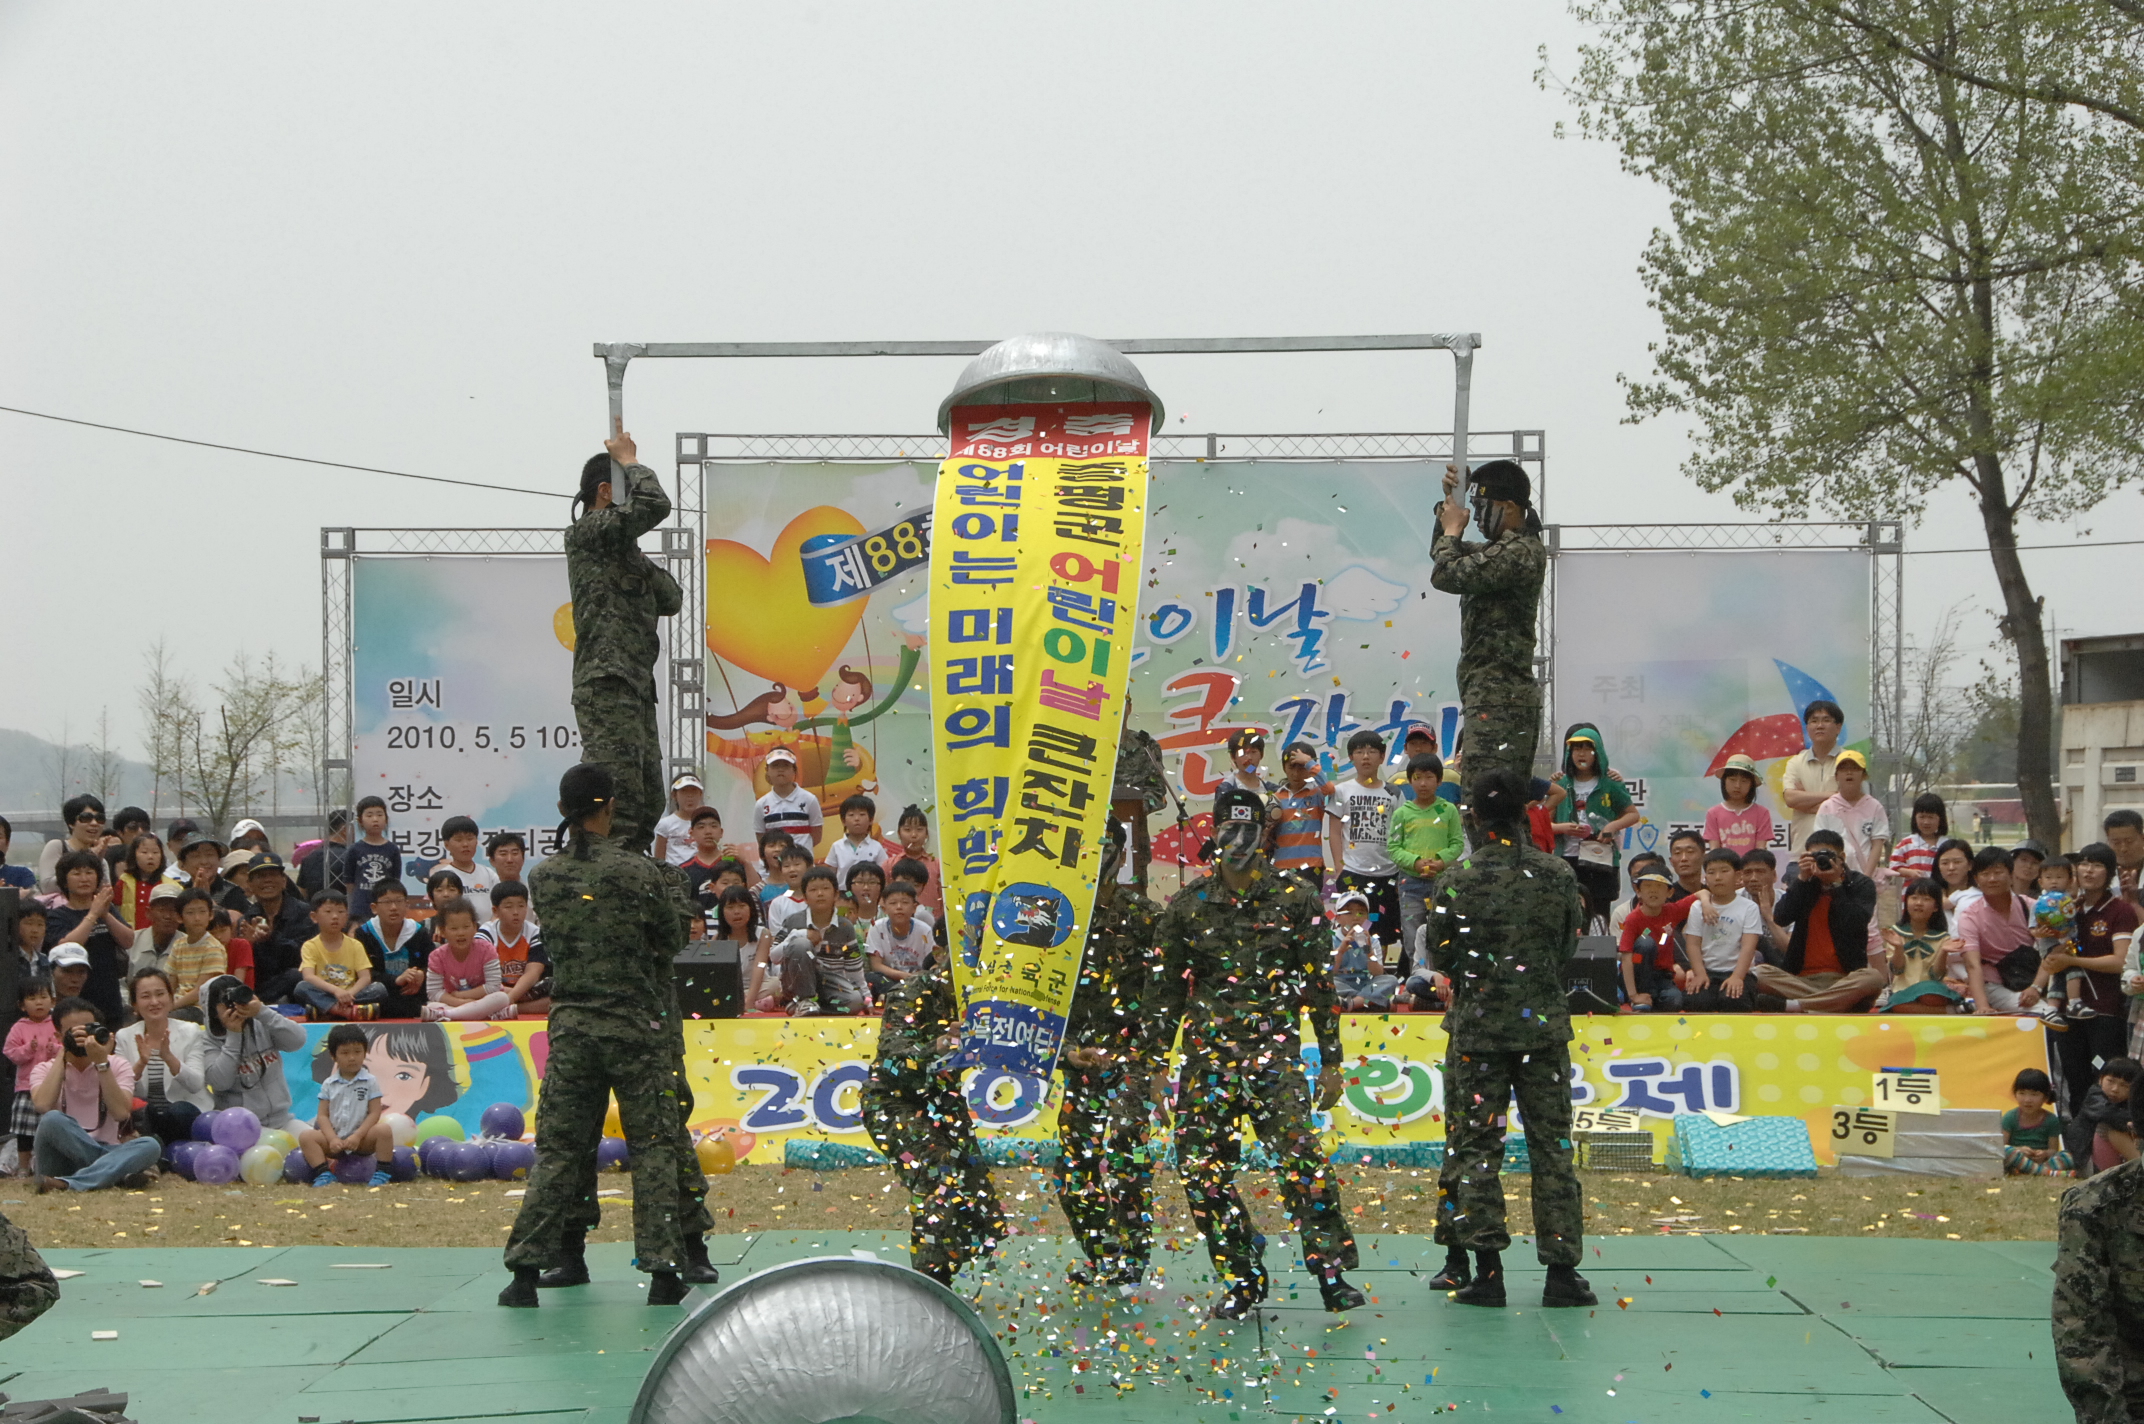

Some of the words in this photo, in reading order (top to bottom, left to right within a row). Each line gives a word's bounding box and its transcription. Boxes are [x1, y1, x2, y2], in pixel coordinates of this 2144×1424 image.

[954, 443, 1033, 459] 제88회
[1040, 440, 1141, 458] 어린이날
[1053, 461, 1128, 548] 증평군
[949, 463, 1025, 585] 어린이는
[1038, 551, 1121, 722] 어린이날
[1131, 582, 1329, 674] 이날
[388, 679, 441, 708] 일시
[944, 608, 1014, 750] 미래의
[1592, 675, 1645, 703] 주최
[387, 784, 444, 813] 장소
[763, 804, 771, 815] 3
[951, 776, 1010, 876] 희망
[391, 828, 451, 858] 보강
[463, 885, 490, 894] llesse
[999, 985, 1008, 994] for
[1010, 987, 1034, 998] Nation
[1041, 994, 1061, 1007] fense
[1875, 1077, 1932, 1105] 1등
[1575, 1110, 1633, 1131] 5등
[1831, 1110, 1889, 1145] 3등
